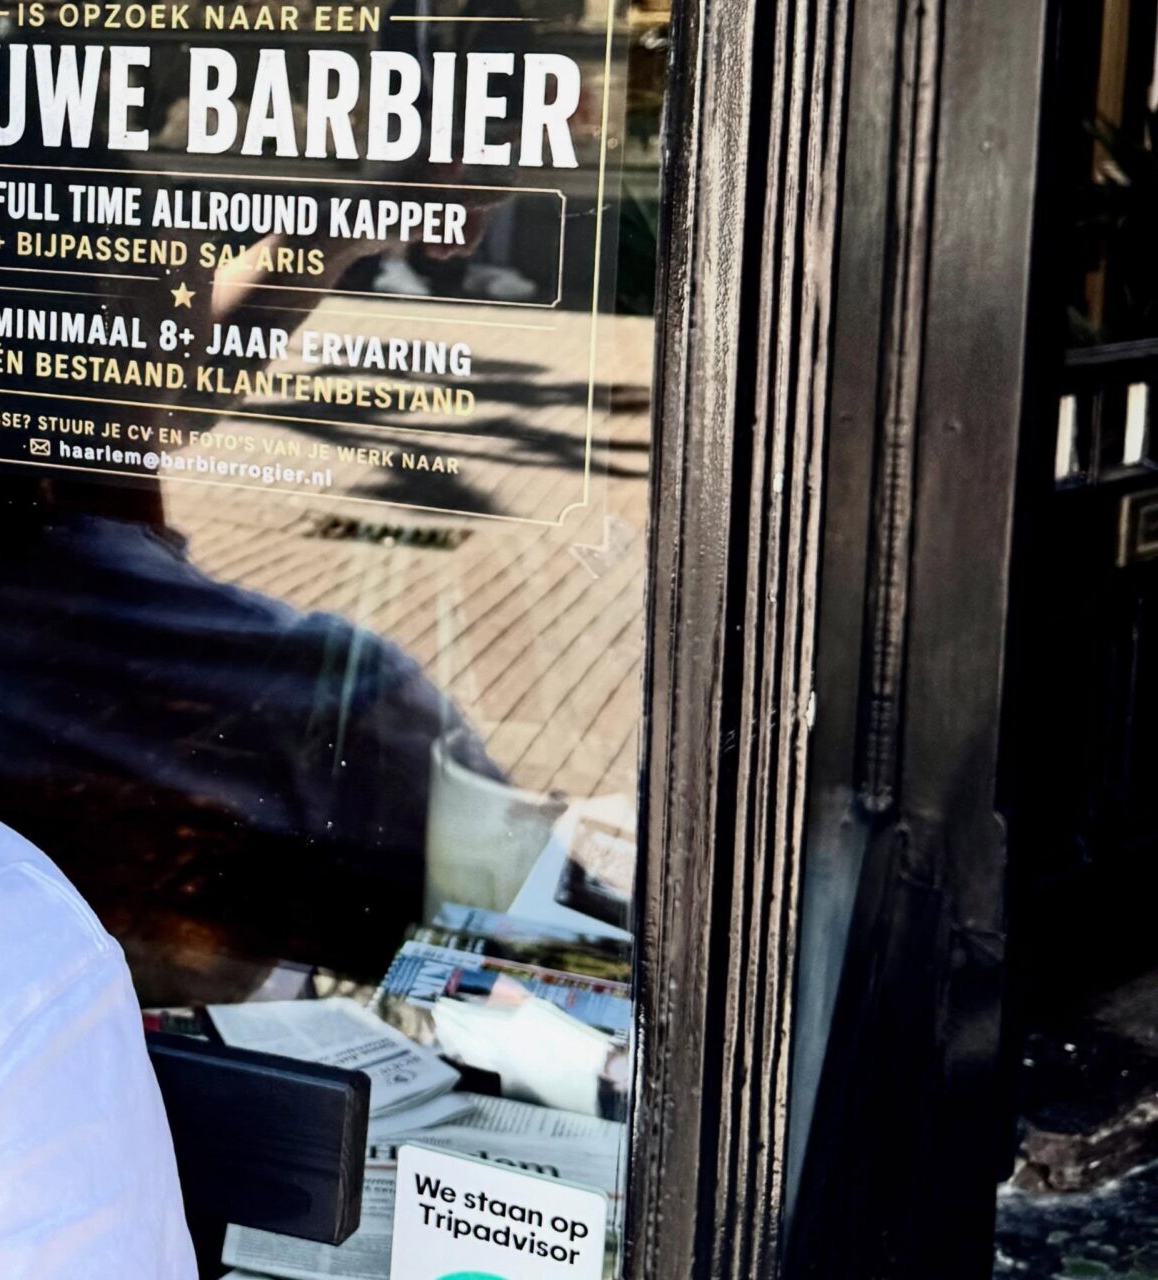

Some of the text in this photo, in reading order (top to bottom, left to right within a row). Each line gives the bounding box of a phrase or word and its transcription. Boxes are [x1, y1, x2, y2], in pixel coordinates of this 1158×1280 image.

[17, 3, 381, 32] IS OPZOEK NAAR EEN
[186, 47, 580, 169] BARBIER
[68, 184, 142, 226] TIME
[151, 188, 319, 236] ALLROUND
[329, 197, 467, 245] KAPPER
[16, 231, 188, 267] BIJPASSEND
[199, 241, 325, 276] SALARIS
[159, 319, 195, 351] 8+
[205, 323, 290, 361] JAAR
[302, 330, 472, 377] ERVARING
[35, 352, 184, 390] BESTAAND
[196, 365, 476, 417] KLANTENBESTAND
[37, 416, 95, 436] STUUR
[100, 422, 122, 439] JE
[126, 424, 153, 442] CV
[158, 427, 183, 446] EN
[188, 430, 255, 452] FOTO'S
[261, 438, 301, 458] VAN
[307, 443, 331, 461] JE
[337, 445, 394, 468] WERK
[401, 453, 459, 475] NAAR
[58, 440, 332, 488] haarlem@barbierrogier.nl
[414, 1172, 457, 1204] We
[463, 1192, 543, 1227] staan
[551, 1214, 589, 1241] op
[418, 1202, 580, 1265] Tripadvisor
